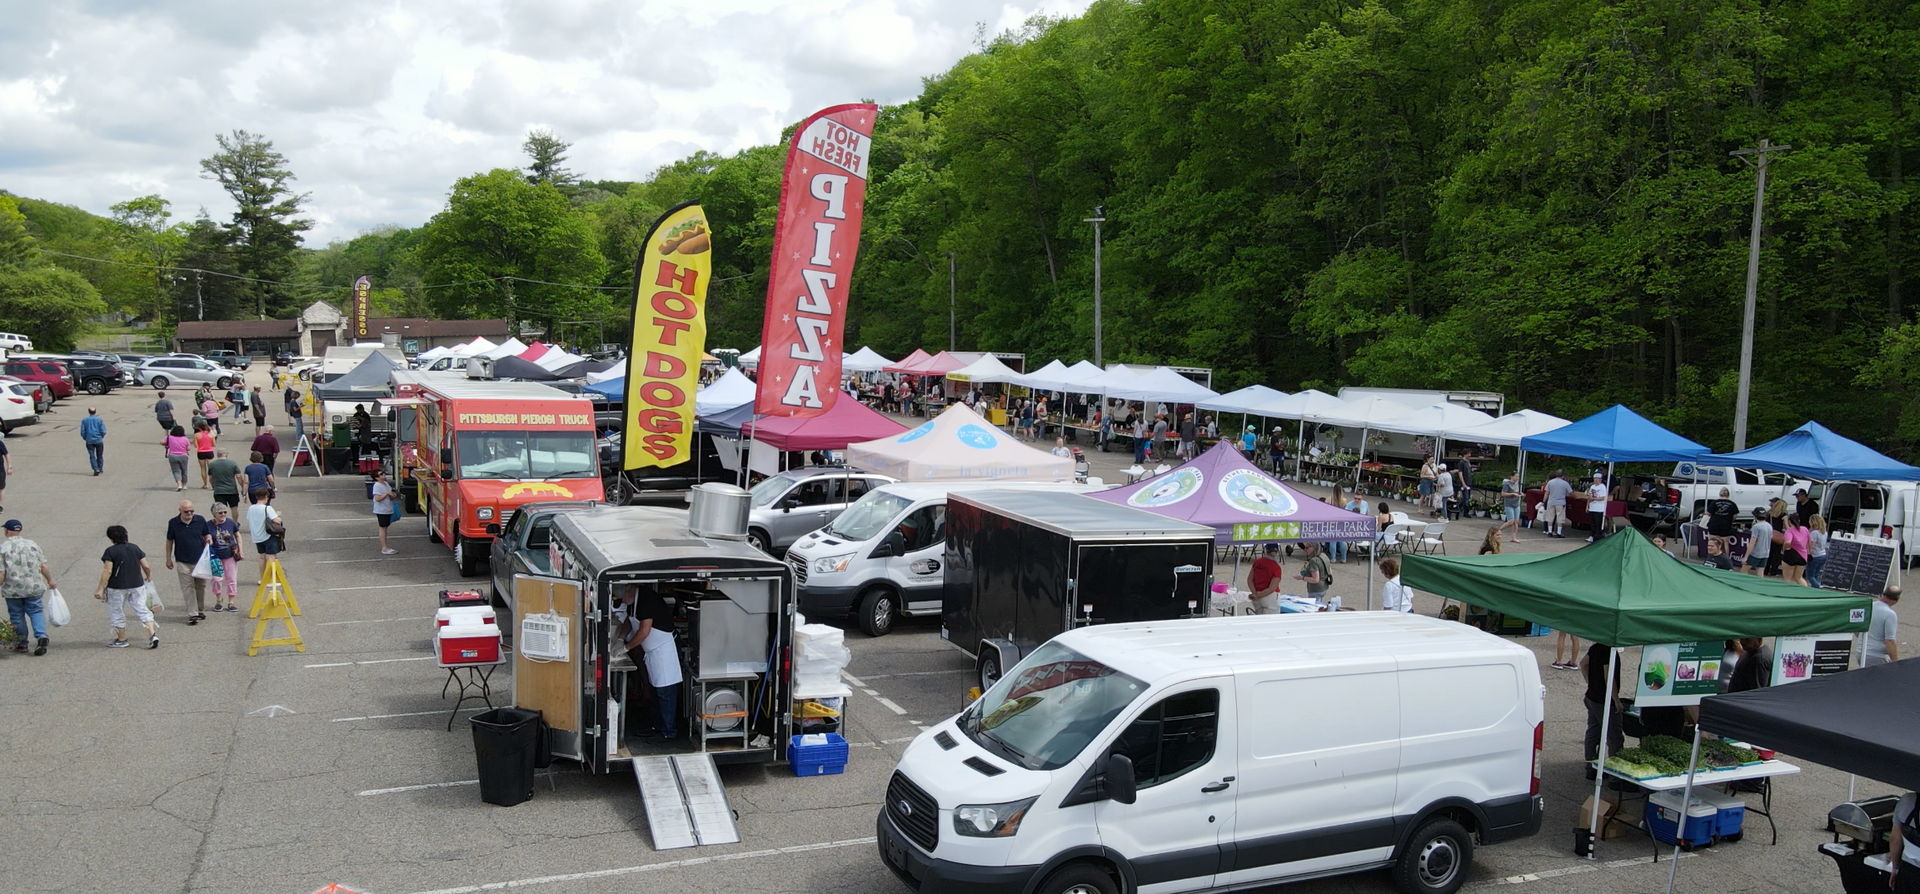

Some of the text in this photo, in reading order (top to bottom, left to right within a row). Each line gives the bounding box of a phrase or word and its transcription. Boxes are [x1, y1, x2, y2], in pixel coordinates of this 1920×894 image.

[637, 260, 698, 460] HOT DOGS
[459, 413, 589, 425] PITTSBURGH PIEROGI TRUCK
[959, 465, 1028, 479] la vigneta
[1301, 520, 1371, 533] BETHEL PARK
